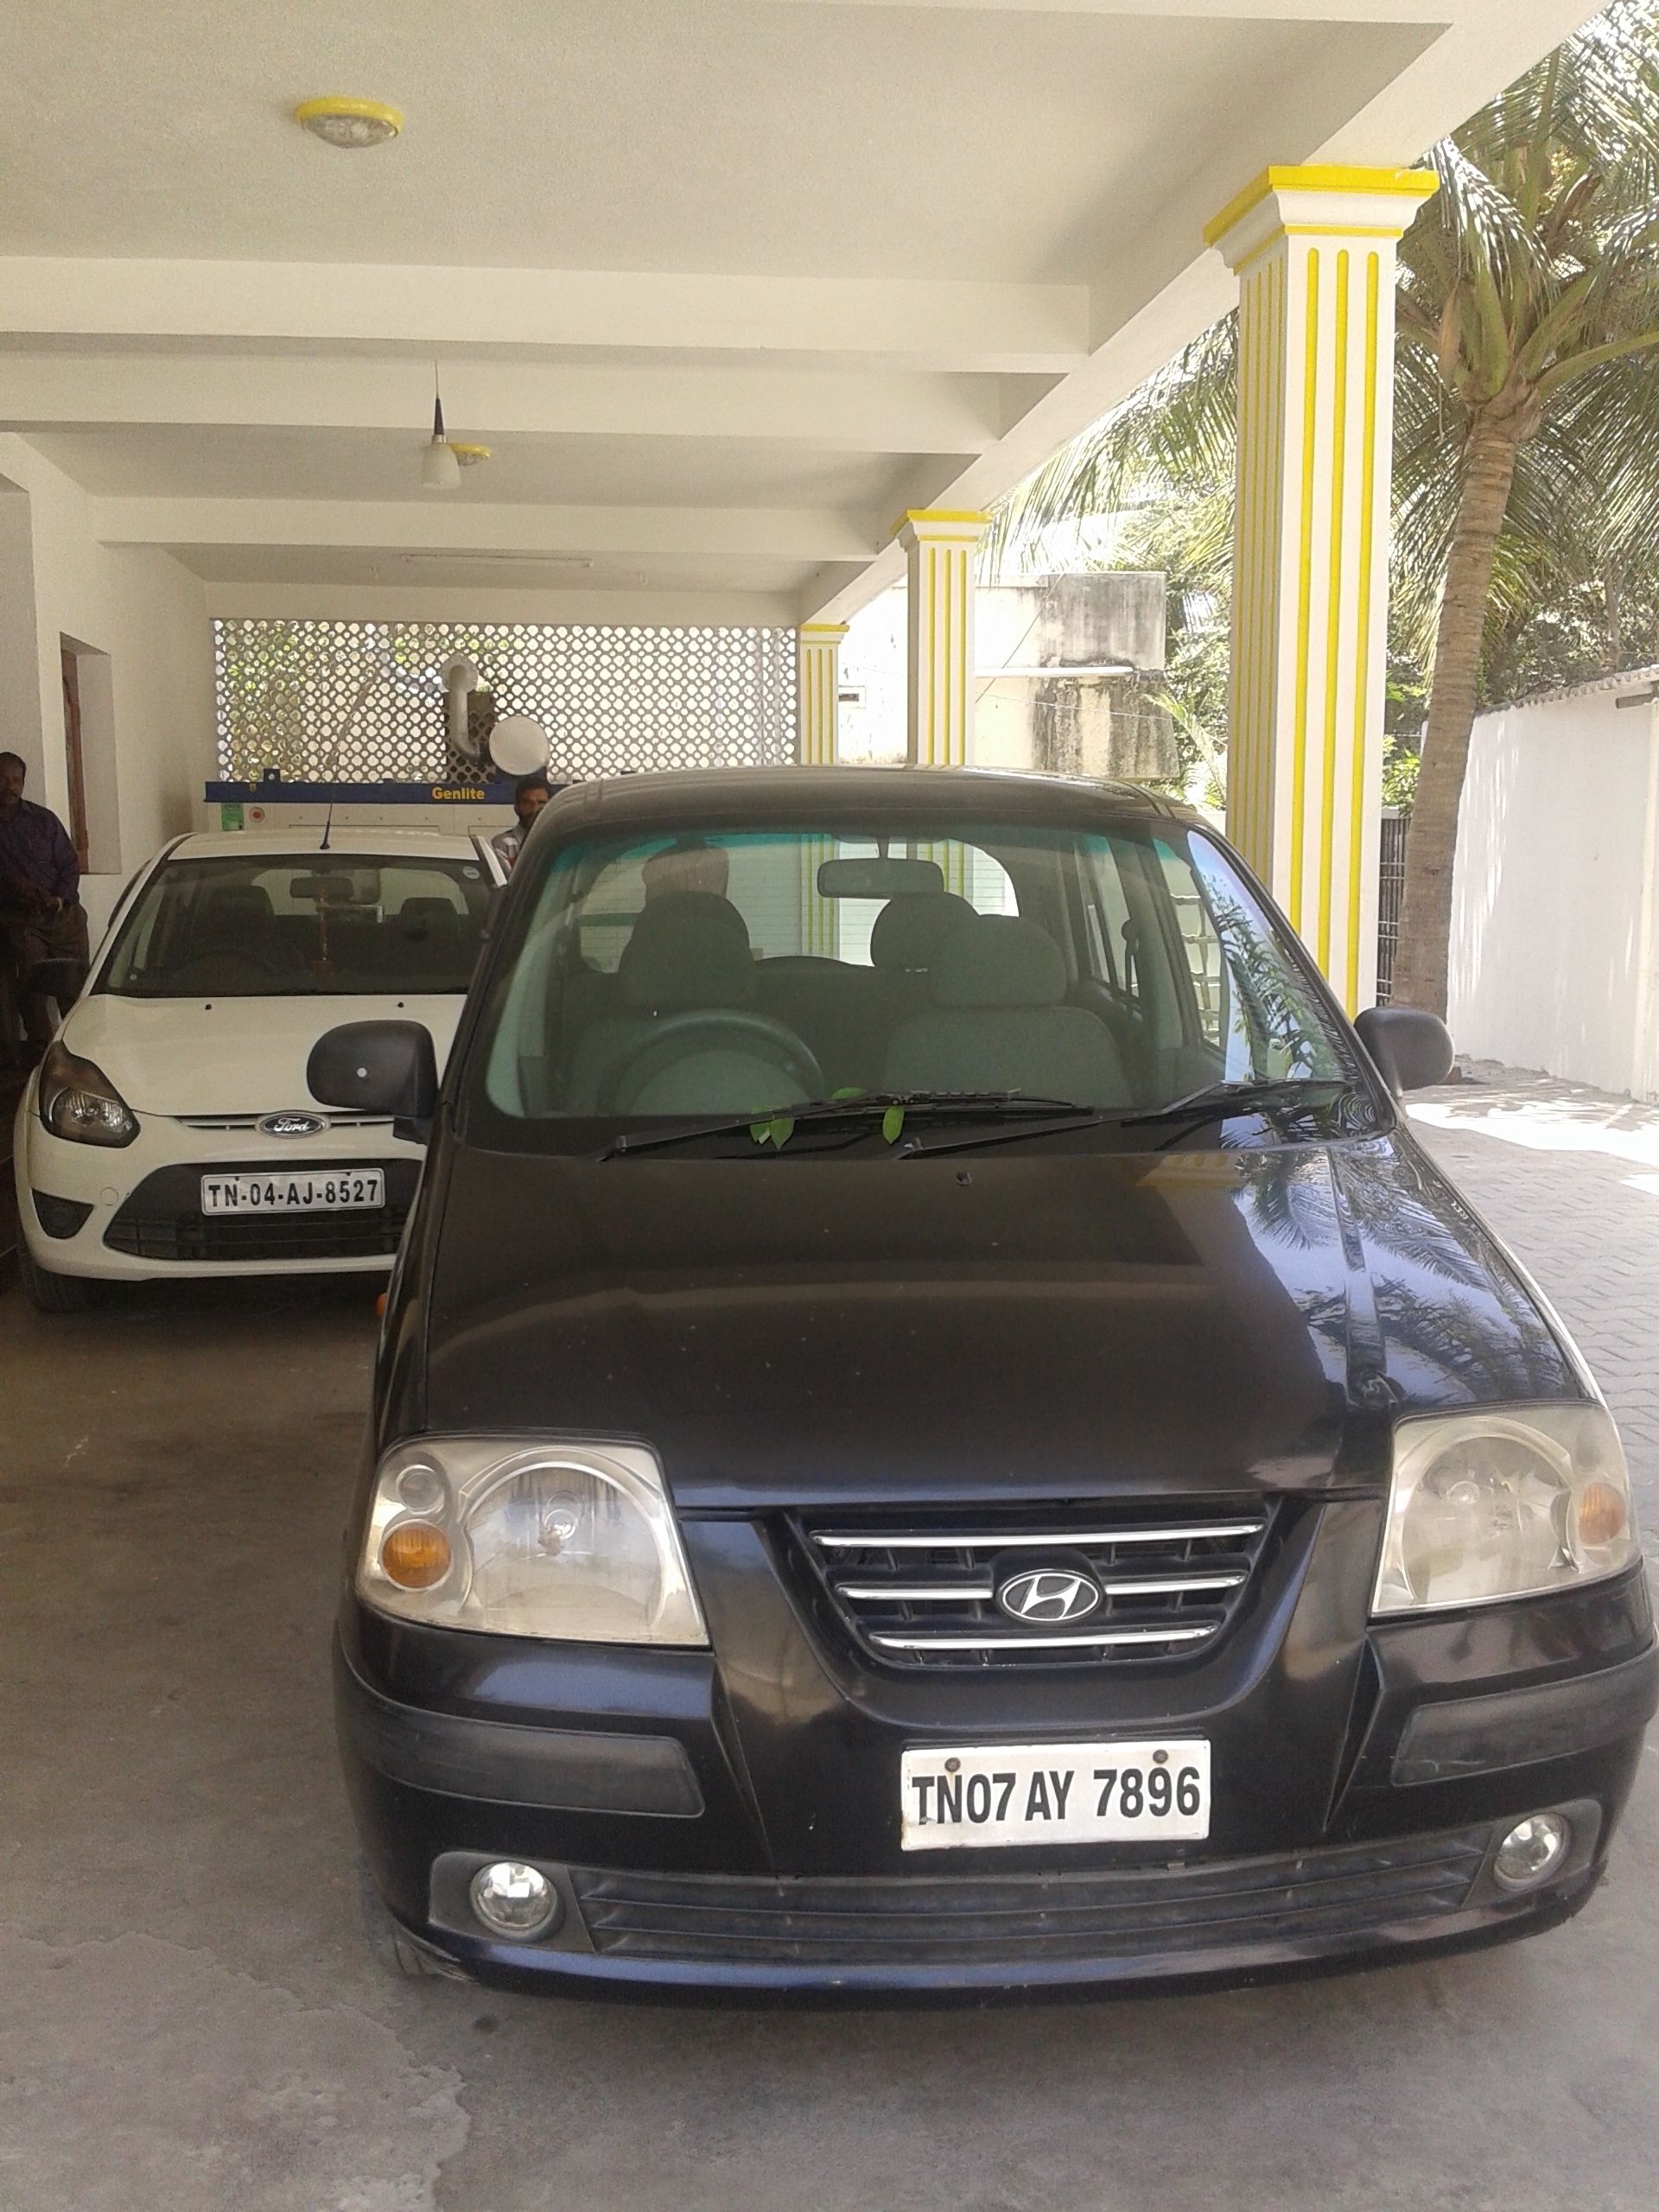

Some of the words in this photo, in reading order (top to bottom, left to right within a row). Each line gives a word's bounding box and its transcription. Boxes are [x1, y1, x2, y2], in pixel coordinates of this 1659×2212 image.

[432, 786, 485, 799] Genlite
[273, 1117, 309, 1132] Ford
[208, 1179, 378, 1207] TN-04-AJ-8527
[912, 1772, 1016, 1825] TN07
[1025, 1770, 1074, 1821] AY
[1093, 1766, 1200, 1818] 7896
